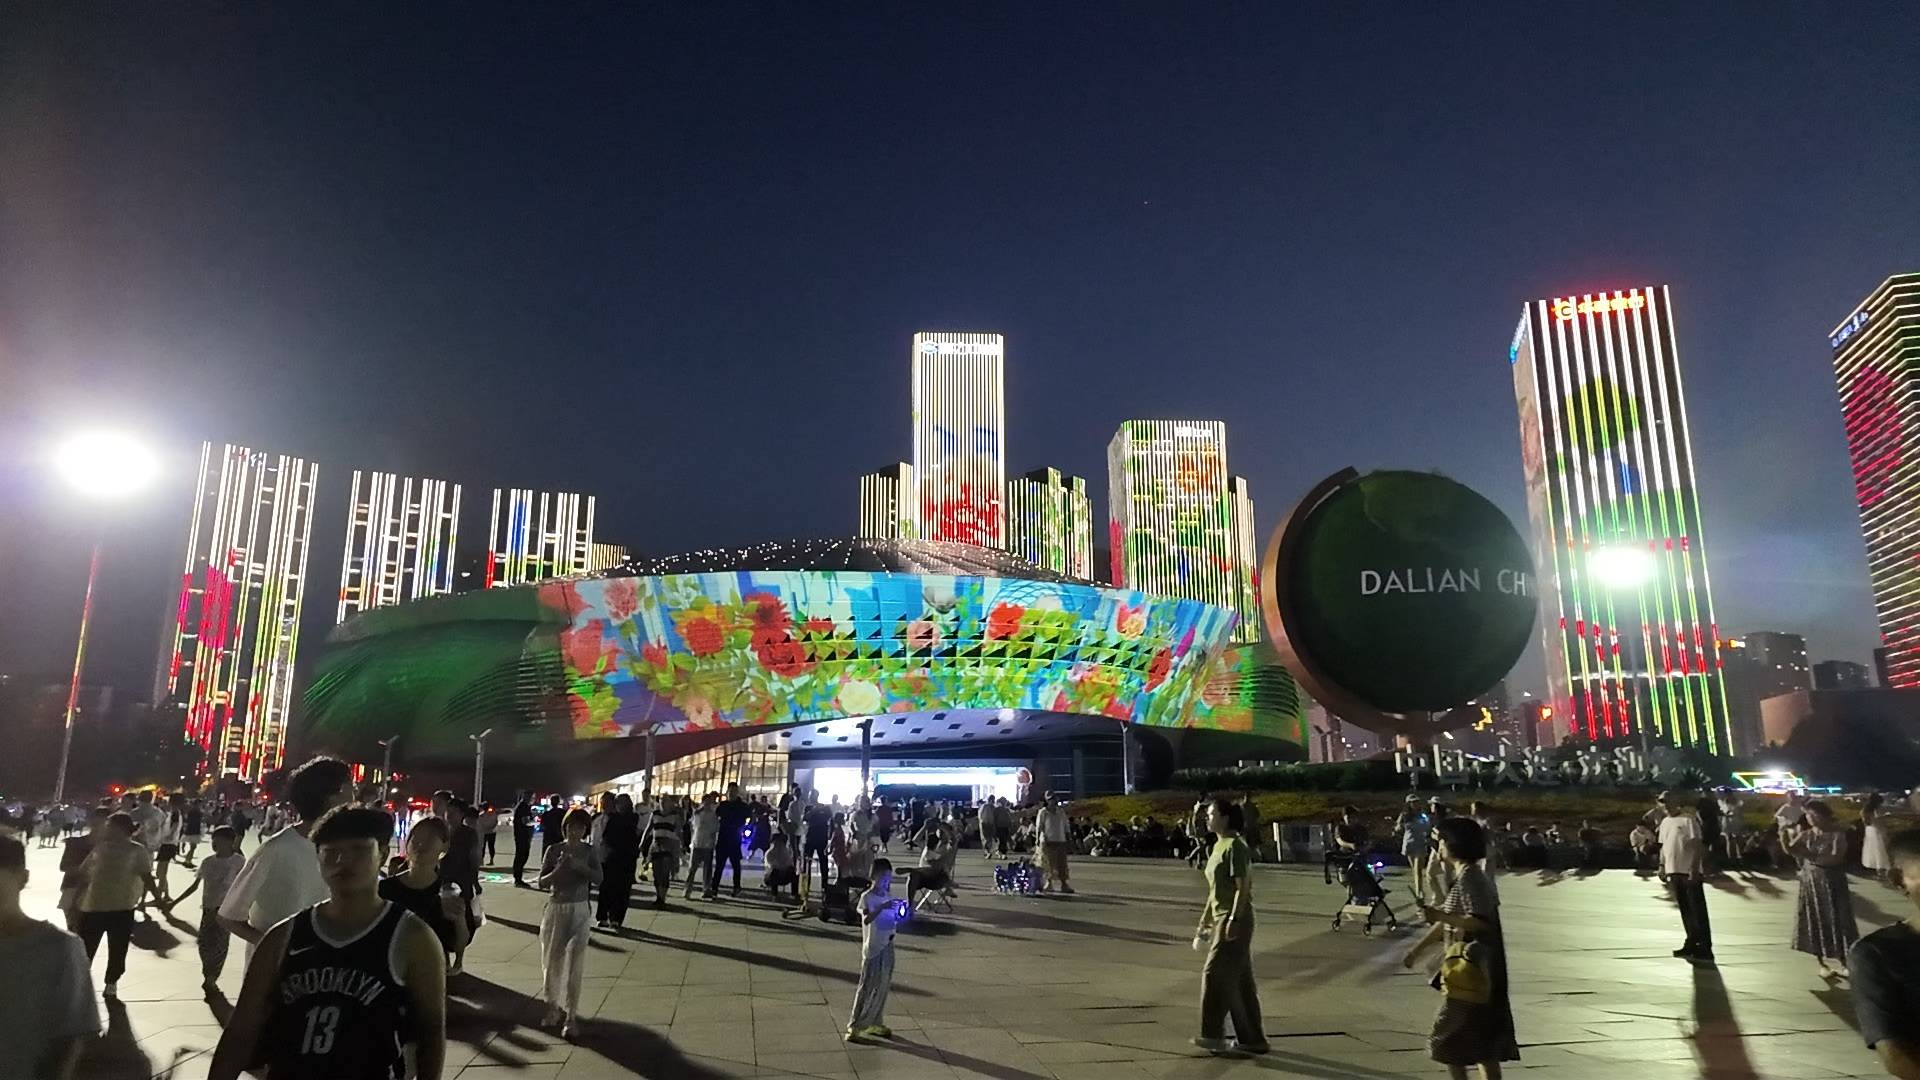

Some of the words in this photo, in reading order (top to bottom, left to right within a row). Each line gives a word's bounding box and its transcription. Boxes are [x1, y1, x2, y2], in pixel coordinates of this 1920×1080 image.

[1360, 567, 1481, 595] DALIAN
[281, 966, 387, 1007] BROOKLYN
[301, 1006, 341, 1055] 13
